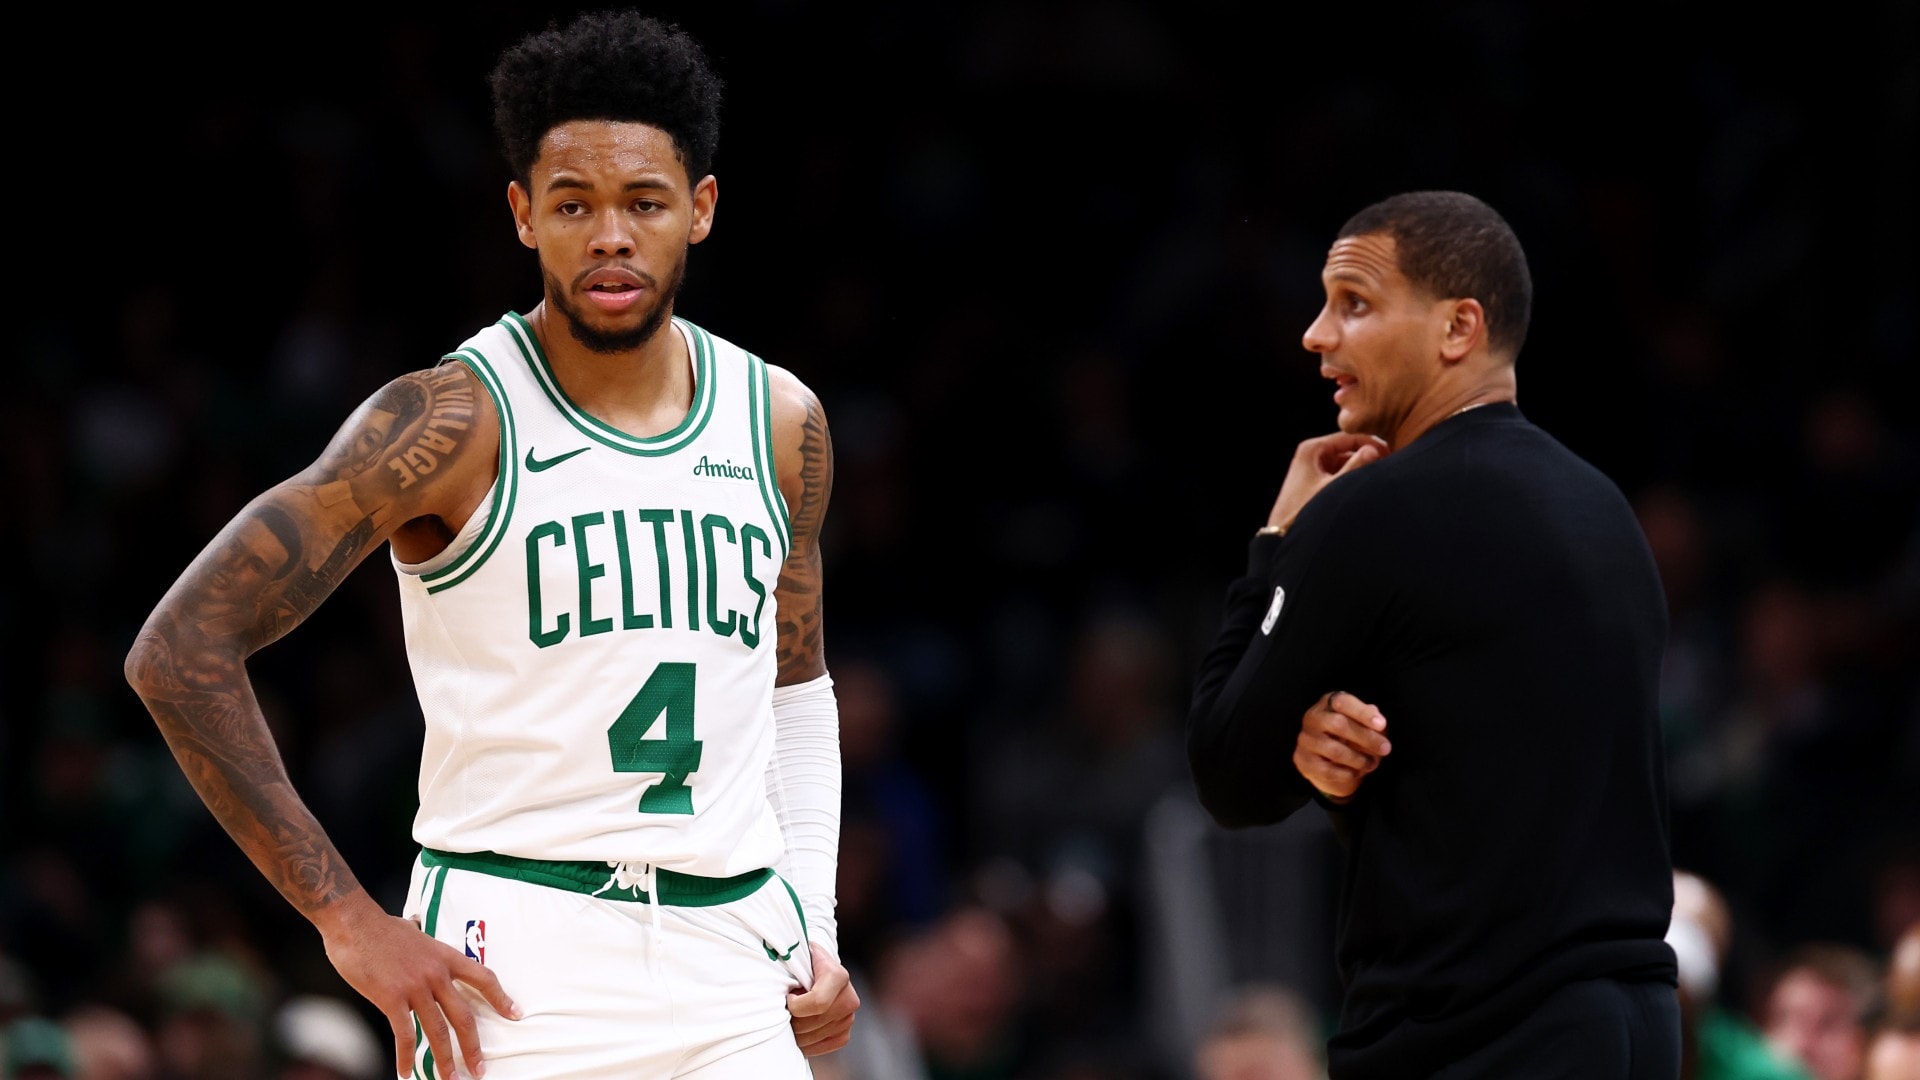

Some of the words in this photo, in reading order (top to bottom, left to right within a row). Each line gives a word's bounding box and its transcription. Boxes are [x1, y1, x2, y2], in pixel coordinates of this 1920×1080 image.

[693, 455, 754, 481] Amica
[525, 509, 771, 649] CELTICS
[607, 662, 703, 815] 4
